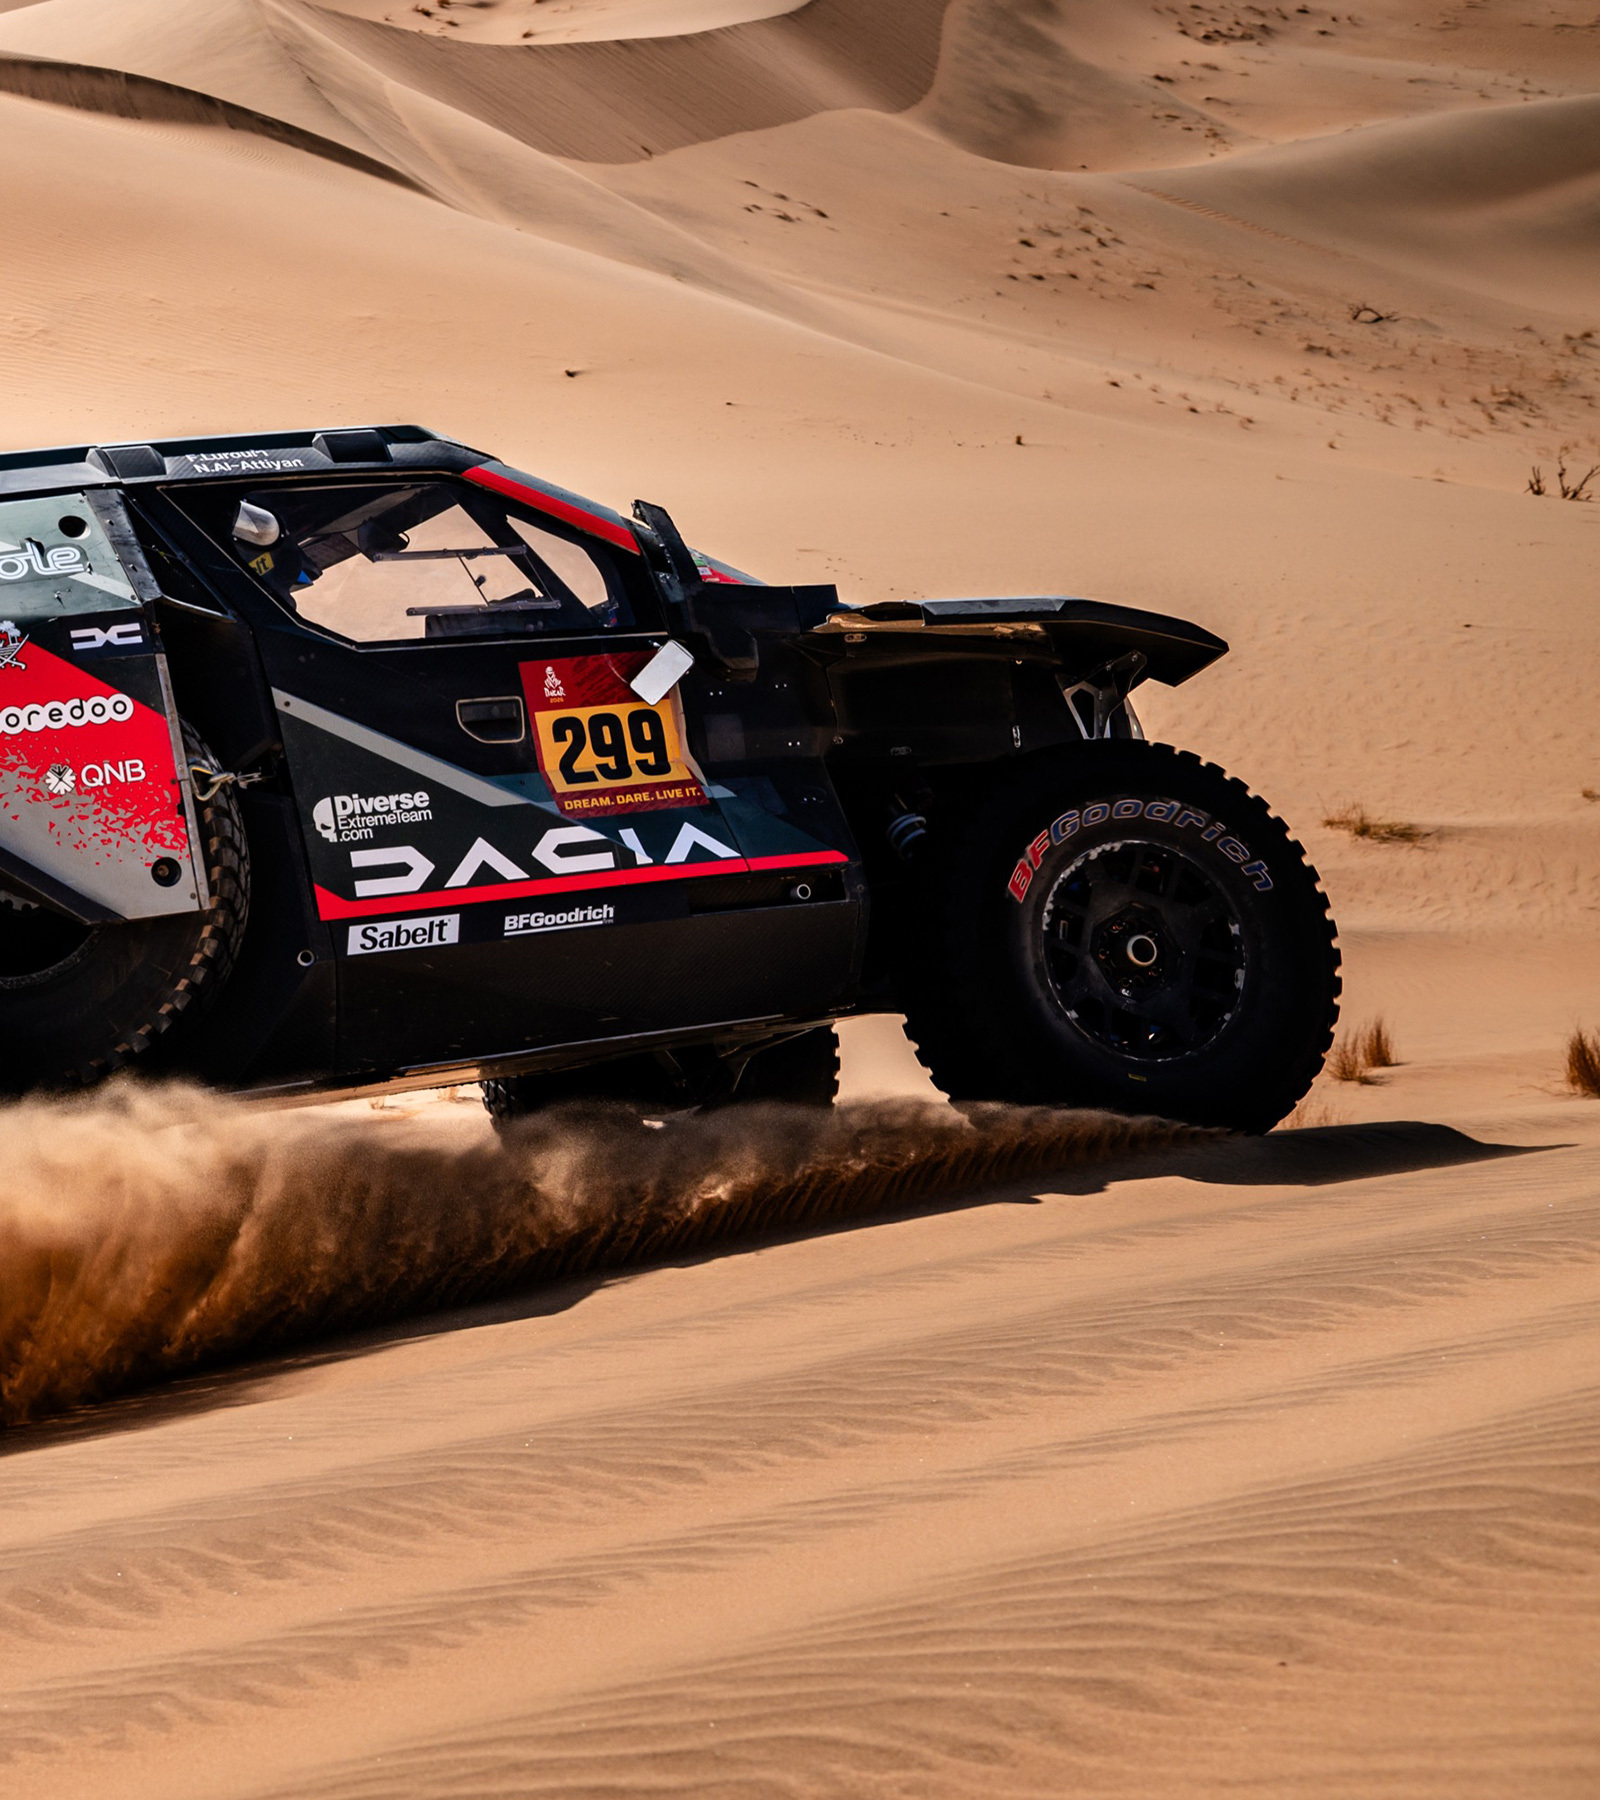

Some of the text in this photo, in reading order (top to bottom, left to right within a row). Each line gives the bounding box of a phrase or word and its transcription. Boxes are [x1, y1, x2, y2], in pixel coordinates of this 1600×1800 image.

[552, 709, 672, 785] 299
[81, 759, 147, 787] QNB
[333, 791, 430, 816] Diverse
[564, 787, 700, 811] DREAM. DARE. LIVE IT.
[337, 809, 433, 830] ExtremeTeam
[339, 828, 374, 842] .com
[350, 822, 742, 897] DACIA
[1008, 799, 1274, 903] BFGoodrich
[504, 904, 615, 931] BFGoodrich
[359, 919, 448, 951] Sabelt
